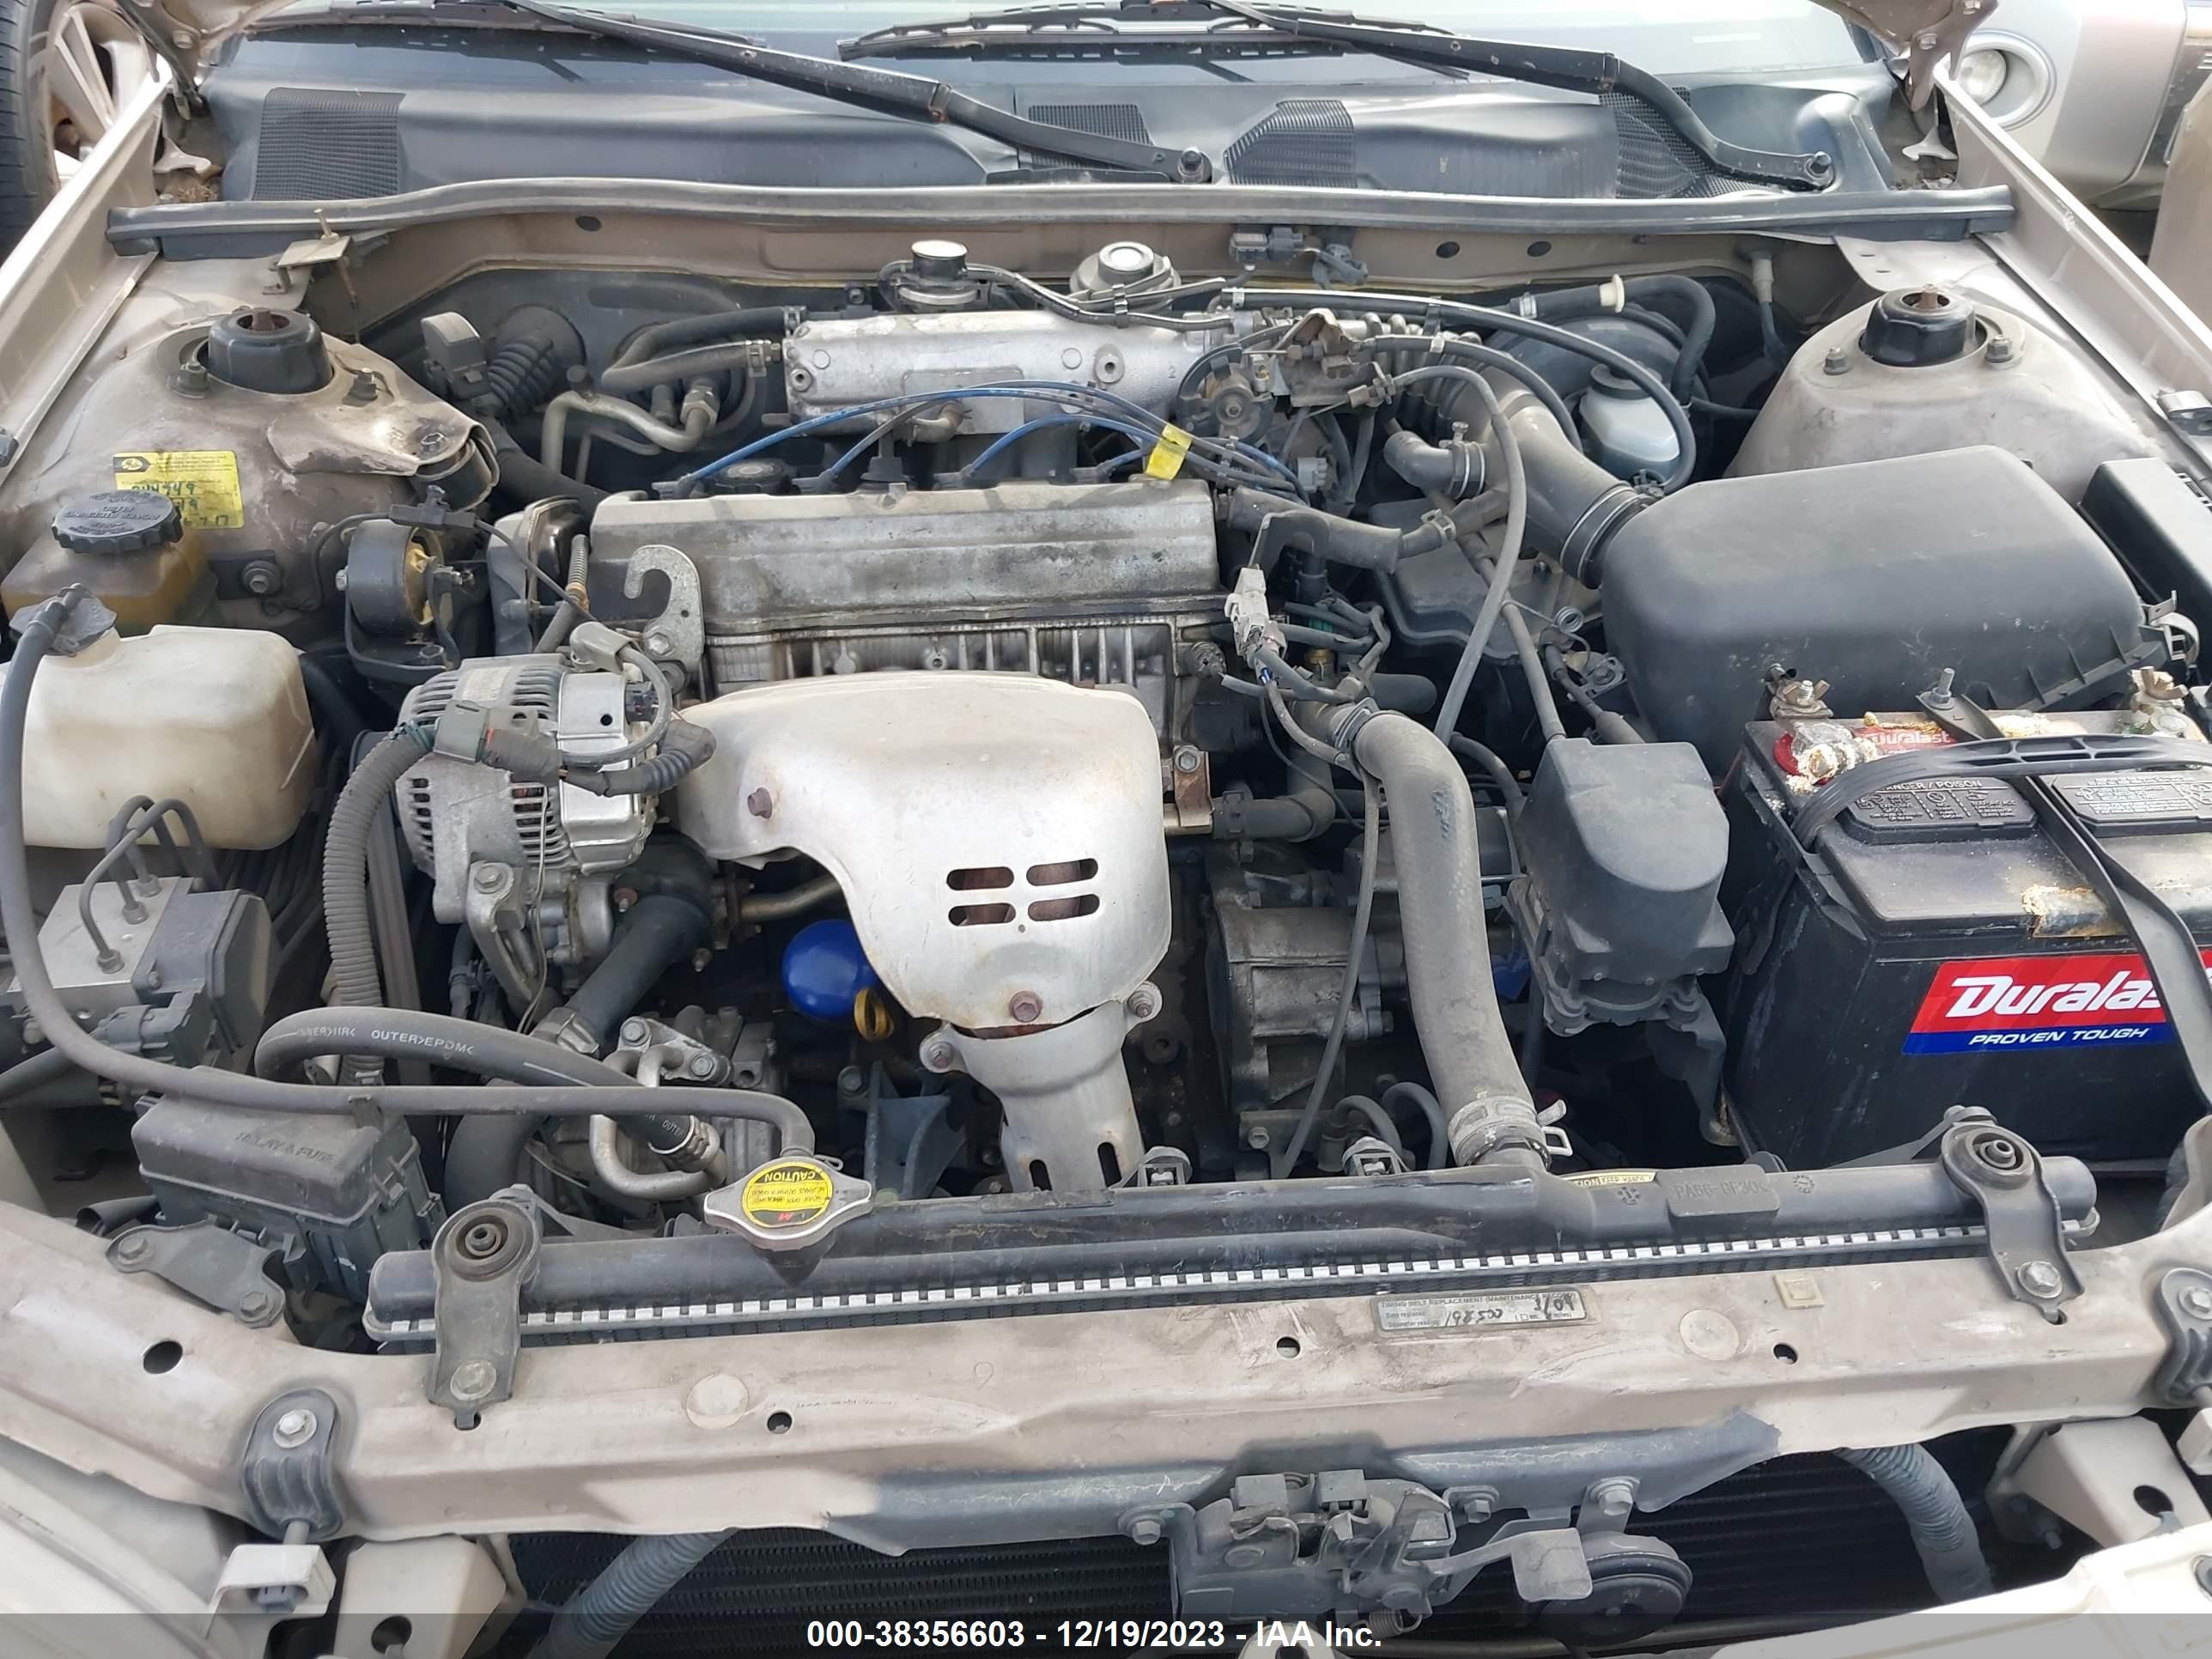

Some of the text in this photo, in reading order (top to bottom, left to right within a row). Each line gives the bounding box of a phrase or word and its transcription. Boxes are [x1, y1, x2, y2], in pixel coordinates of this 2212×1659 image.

[1936, 780, 1983, 788] POISON
[1969, 1028, 2150, 1045] PROVEN TOUGH
[764, 1170, 816, 1182] CAUTION
[1429, 1297, 1484, 1305] REPLACEMENT
